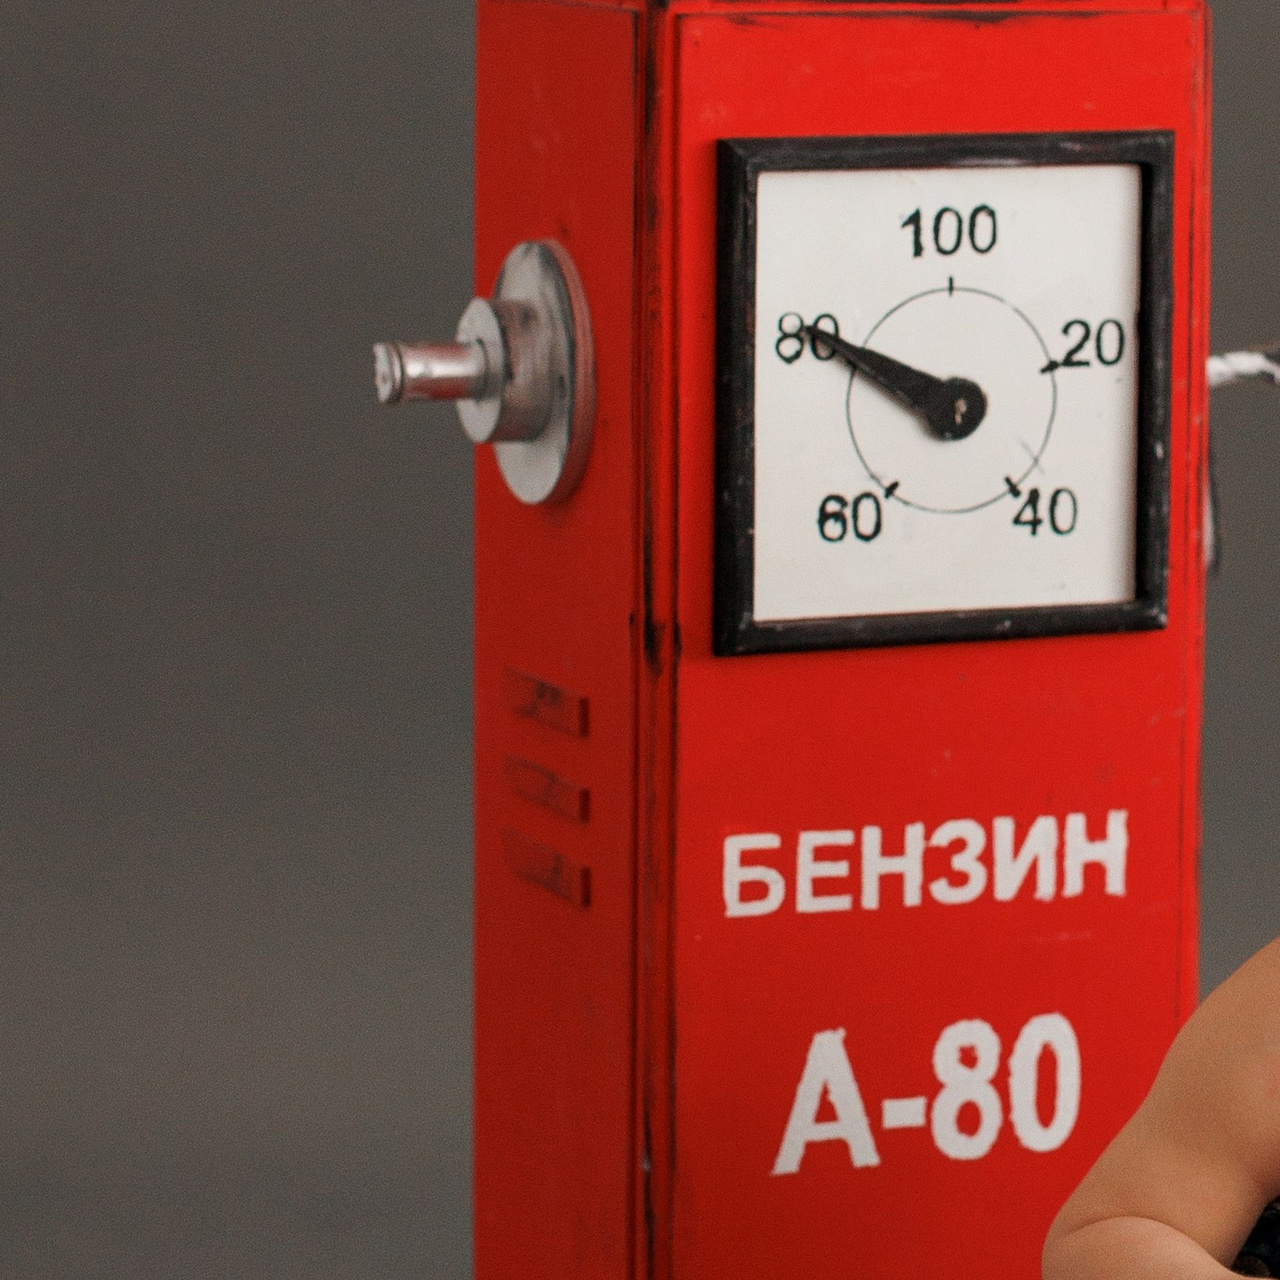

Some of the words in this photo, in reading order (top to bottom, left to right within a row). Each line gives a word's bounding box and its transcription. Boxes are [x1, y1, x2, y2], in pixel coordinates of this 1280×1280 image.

[901, 204, 998, 258] 100
[775, 312, 840, 364] 80
[1059, 319, 1126, 368] 20
[817, 492, 883, 543] 60
[1012, 487, 1079, 536] 40
[722, 808, 1128, 918] БЕНЗИН
[770, 1012, 1082, 1177] А-80
